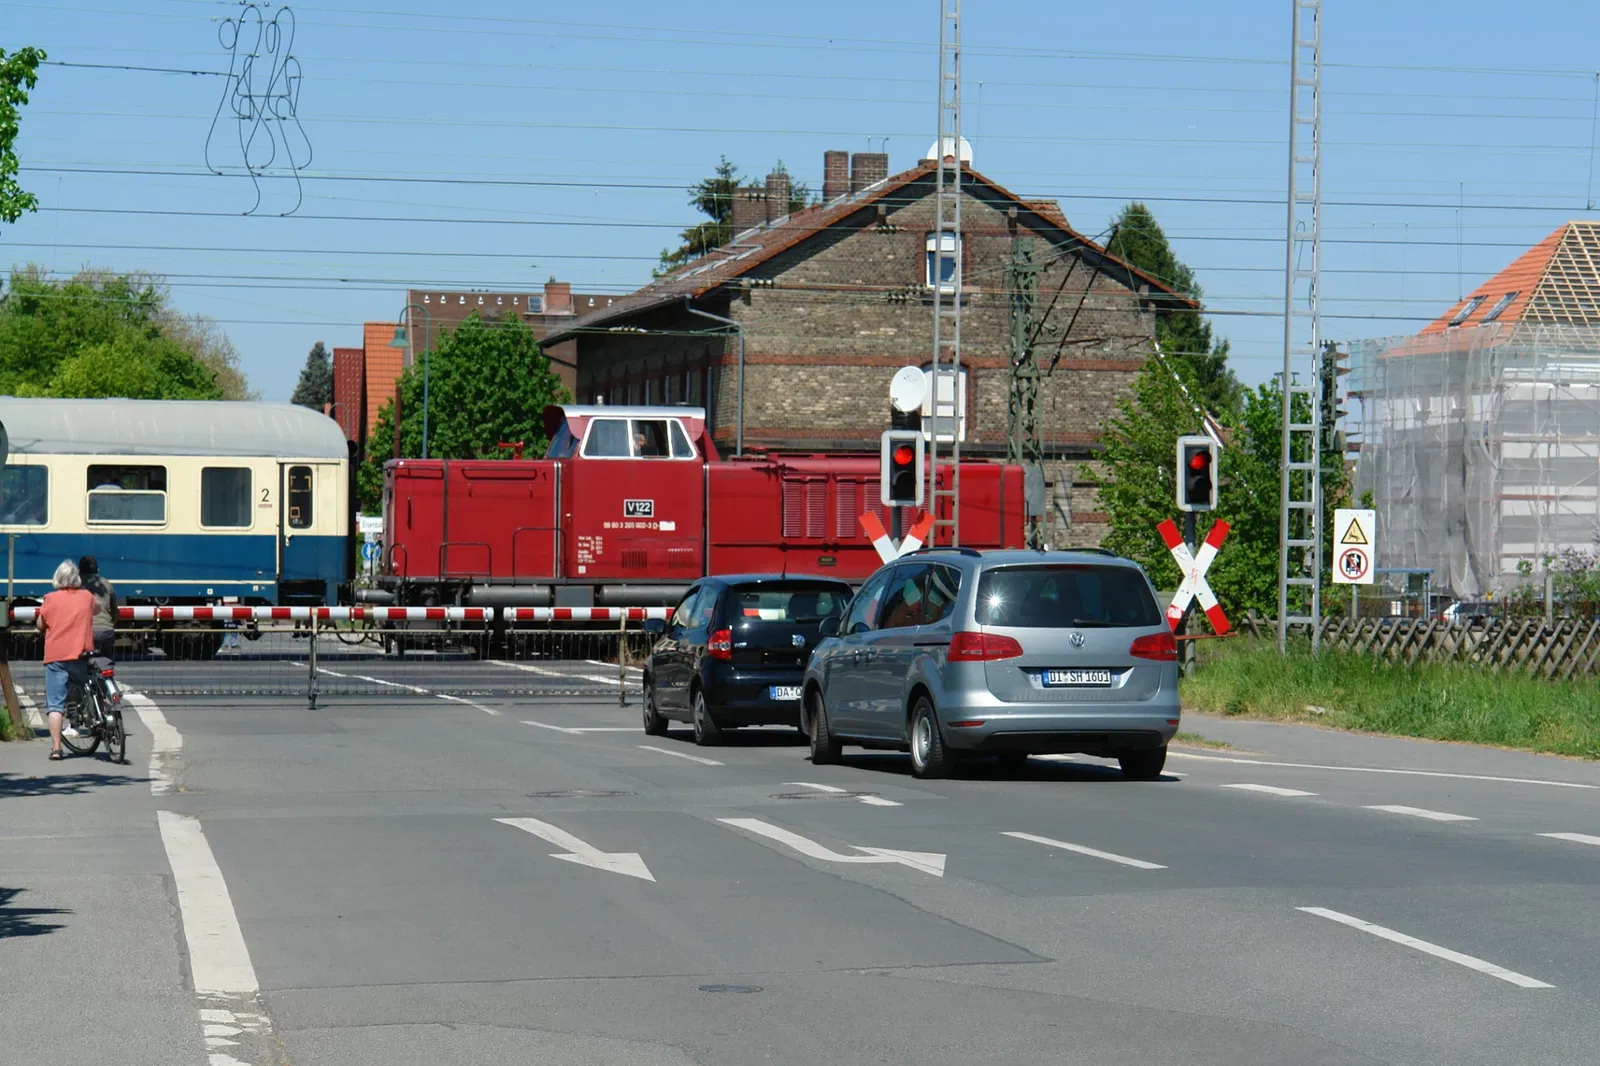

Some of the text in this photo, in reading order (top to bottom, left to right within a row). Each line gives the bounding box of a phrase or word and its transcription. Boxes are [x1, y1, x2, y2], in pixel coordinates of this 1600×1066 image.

[261, 488, 270, 502] 2
[1049, 671, 1110, 683] DI SH 1601
[776, 687, 789, 697] DA
